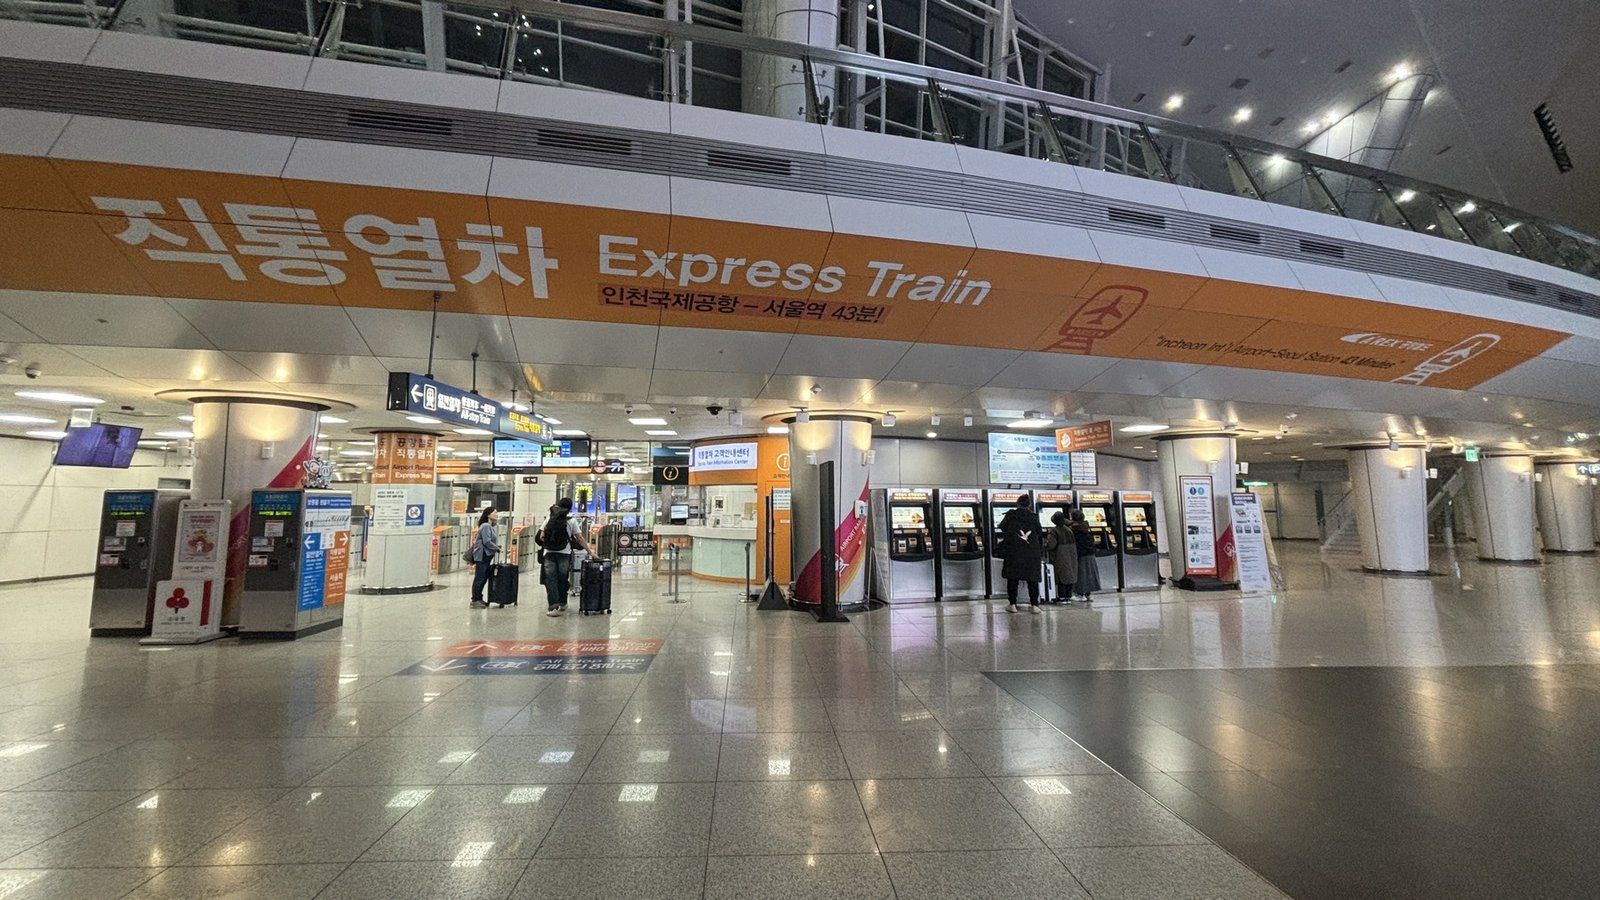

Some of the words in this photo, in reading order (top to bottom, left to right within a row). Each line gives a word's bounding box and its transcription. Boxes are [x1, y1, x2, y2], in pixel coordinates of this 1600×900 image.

[90, 196, 559, 299] 직통열차
[598, 234, 846, 293] Express
[866, 260, 992, 306] Train
[601, 285, 740, 314] 인천국제공항
[762, 299, 826, 320] 서울역
[832, 304, 885, 324] 43분!
